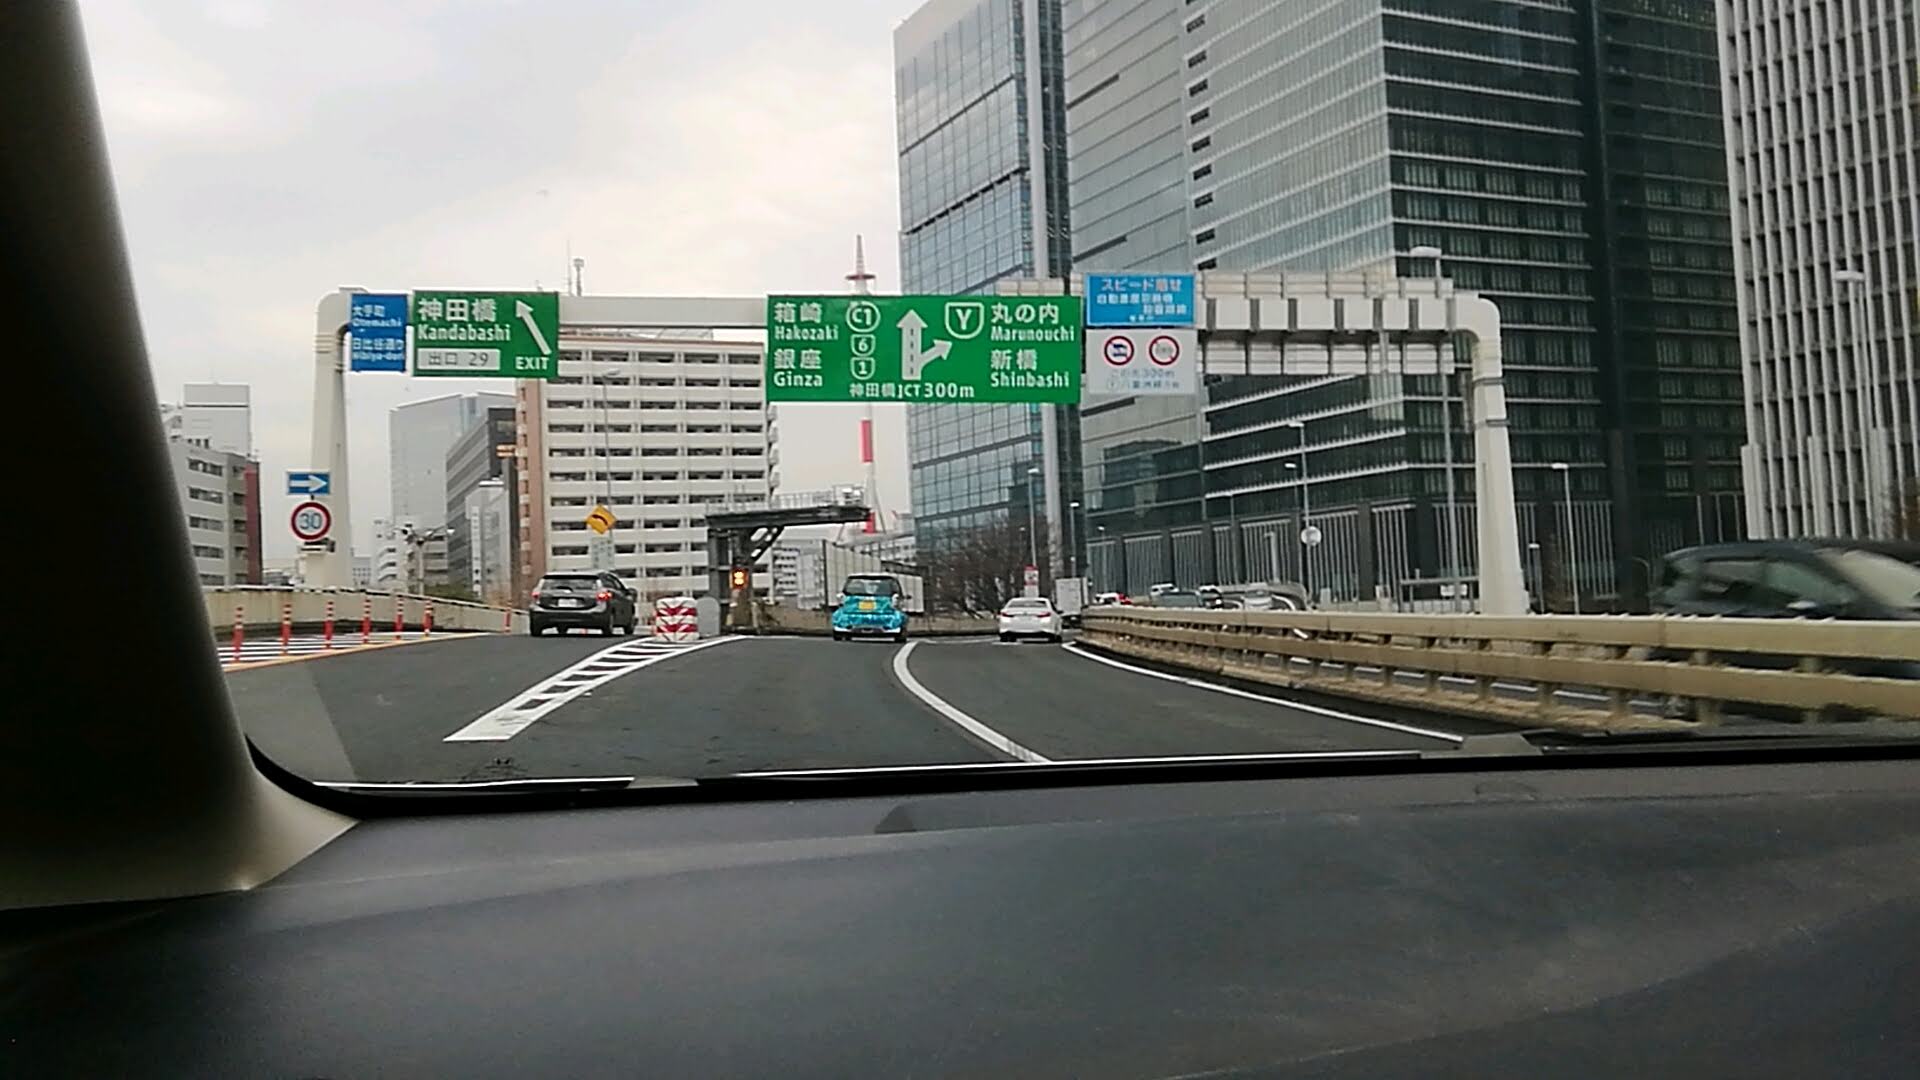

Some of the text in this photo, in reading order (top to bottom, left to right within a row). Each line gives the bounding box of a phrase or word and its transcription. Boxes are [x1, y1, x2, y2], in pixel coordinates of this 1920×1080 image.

[418, 298, 497, 322] 神田橋
[774, 302, 822, 324] 箱崎
[852, 308, 872, 325] C1
[991, 303, 1060, 324] 丸の内
[352, 317, 402, 327] Otemachi
[956, 308, 972, 330] Y
[417, 324, 511, 341] Kandabashi
[774, 325, 839, 341] Hakozaki
[990, 326, 1075, 341] Marunouchi
[858, 338, 868, 352] 6
[428, 352, 489, 366] 出口 29
[515, 357, 550, 370] EXIT
[774, 348, 822, 370] 銀座
[991, 349, 1038, 370] 新橋
[859, 361, 868, 375] 1
[773, 371, 823, 387] Ginza
[990, 371, 1070, 388] Shinbashi
[299, 512, 323, 530] 30
